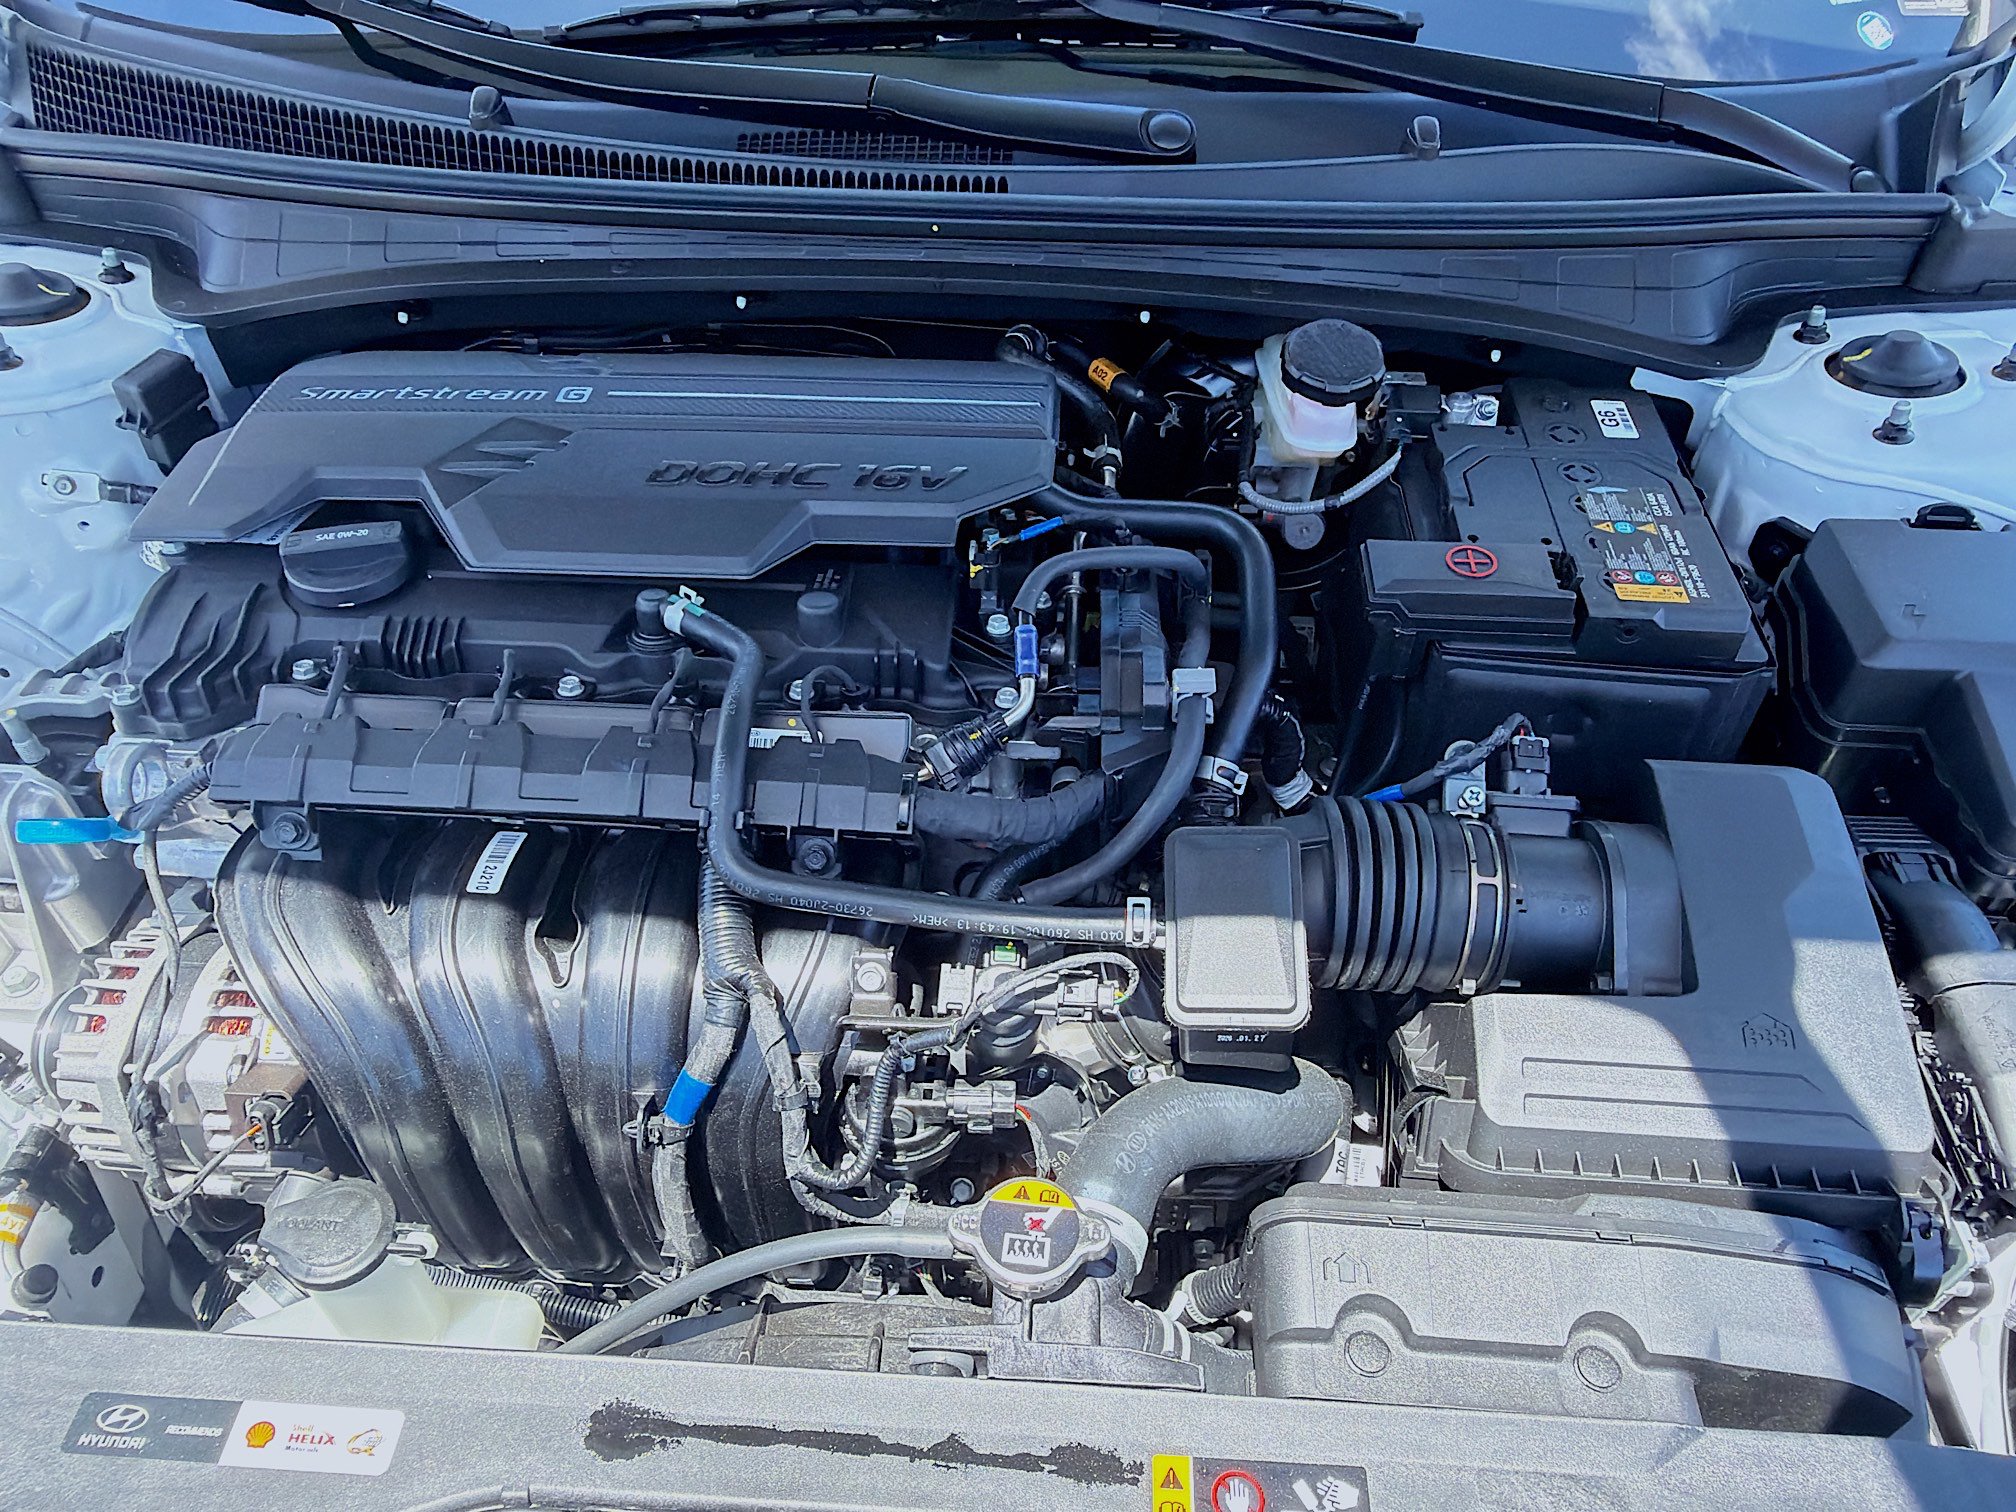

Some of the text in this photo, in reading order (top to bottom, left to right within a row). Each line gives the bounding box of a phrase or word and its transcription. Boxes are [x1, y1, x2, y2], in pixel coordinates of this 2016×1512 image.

[1092, 365, 1108, 382] A02
[300, 386, 591, 402] Smartstream G
[1597, 410, 1620, 428] G6
[645, 459, 968, 490] DOHC 16V
[315, 528, 369, 542] SAE 0W-20
[476, 865, 498, 891] 2J210
[790, 896, 874, 917] 26730-2J040
[1077, 929, 1094, 941] HS
[77, 1424, 224, 1450] HYUNDAI RECOMMENDS
[287, 1430, 336, 1446] HELIX
